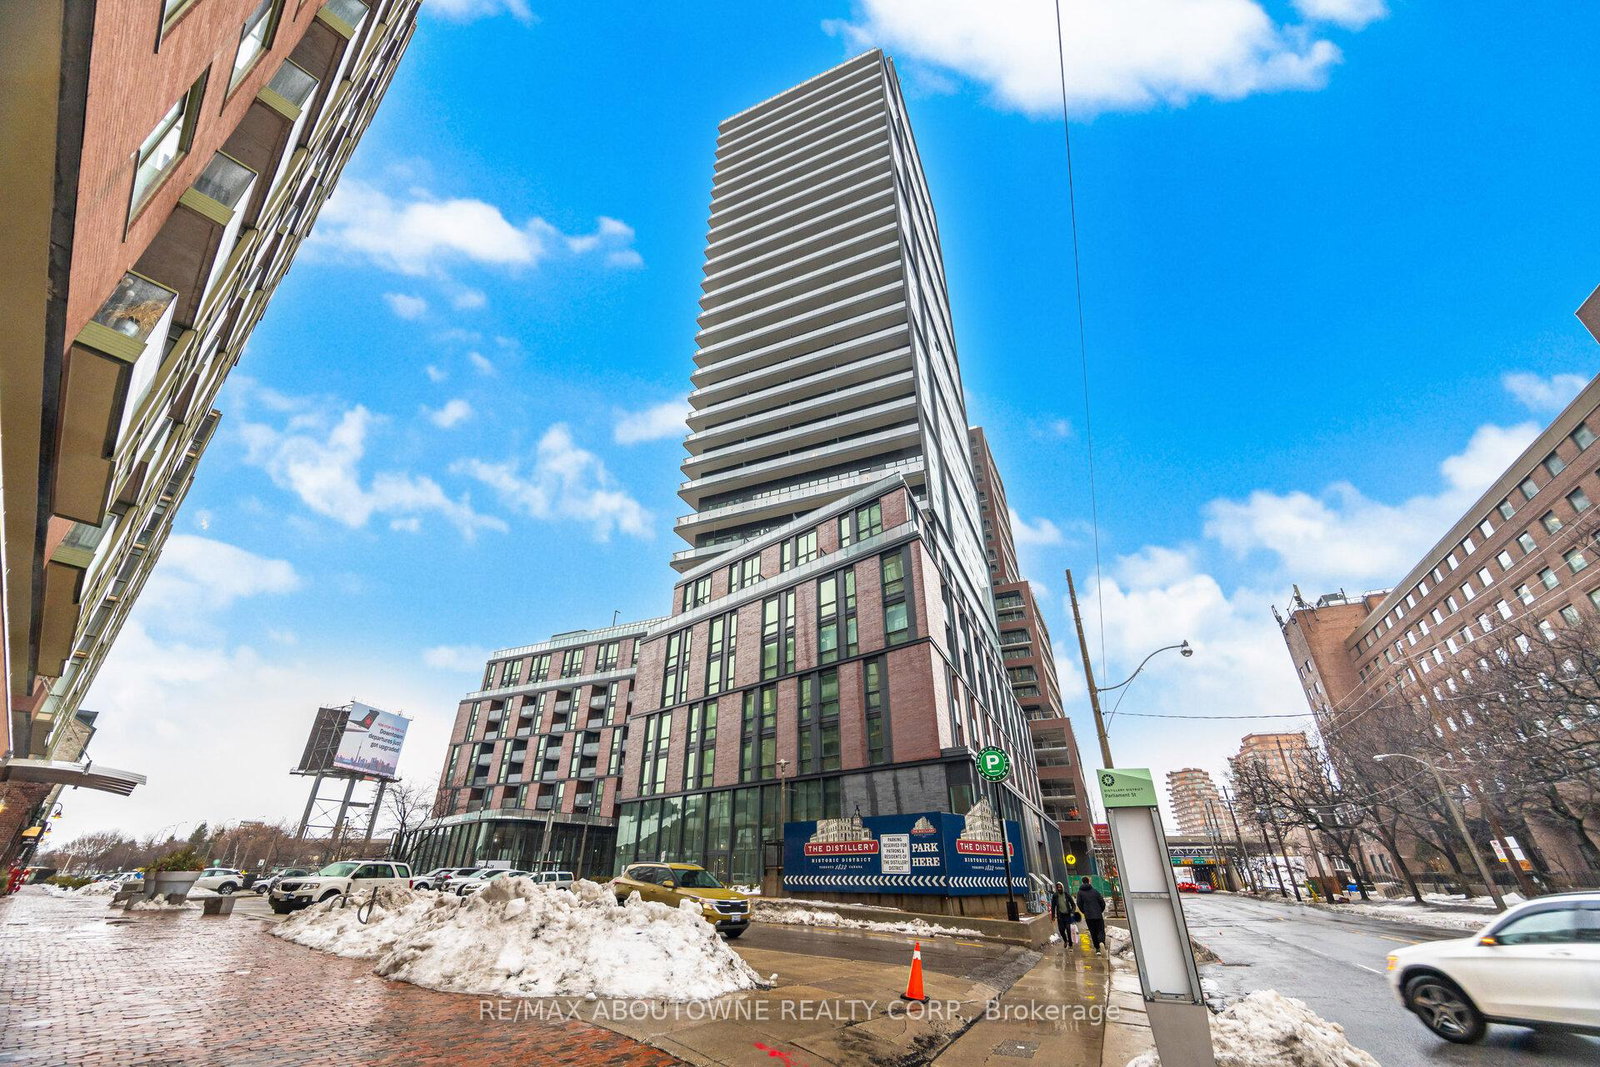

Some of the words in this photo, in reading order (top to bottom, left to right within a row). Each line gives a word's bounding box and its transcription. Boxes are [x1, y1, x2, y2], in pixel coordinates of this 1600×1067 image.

[380, 728, 404, 740] Downtown
[368, 734, 392, 744] departures
[379, 744, 400, 753] upgraded
[986, 754, 1000, 769] P
[826, 844, 874, 852] DISTILLERY
[912, 843, 939, 852] PARK
[976, 844, 1005, 852] DISTILLE
[912, 857, 940, 866] HERE
